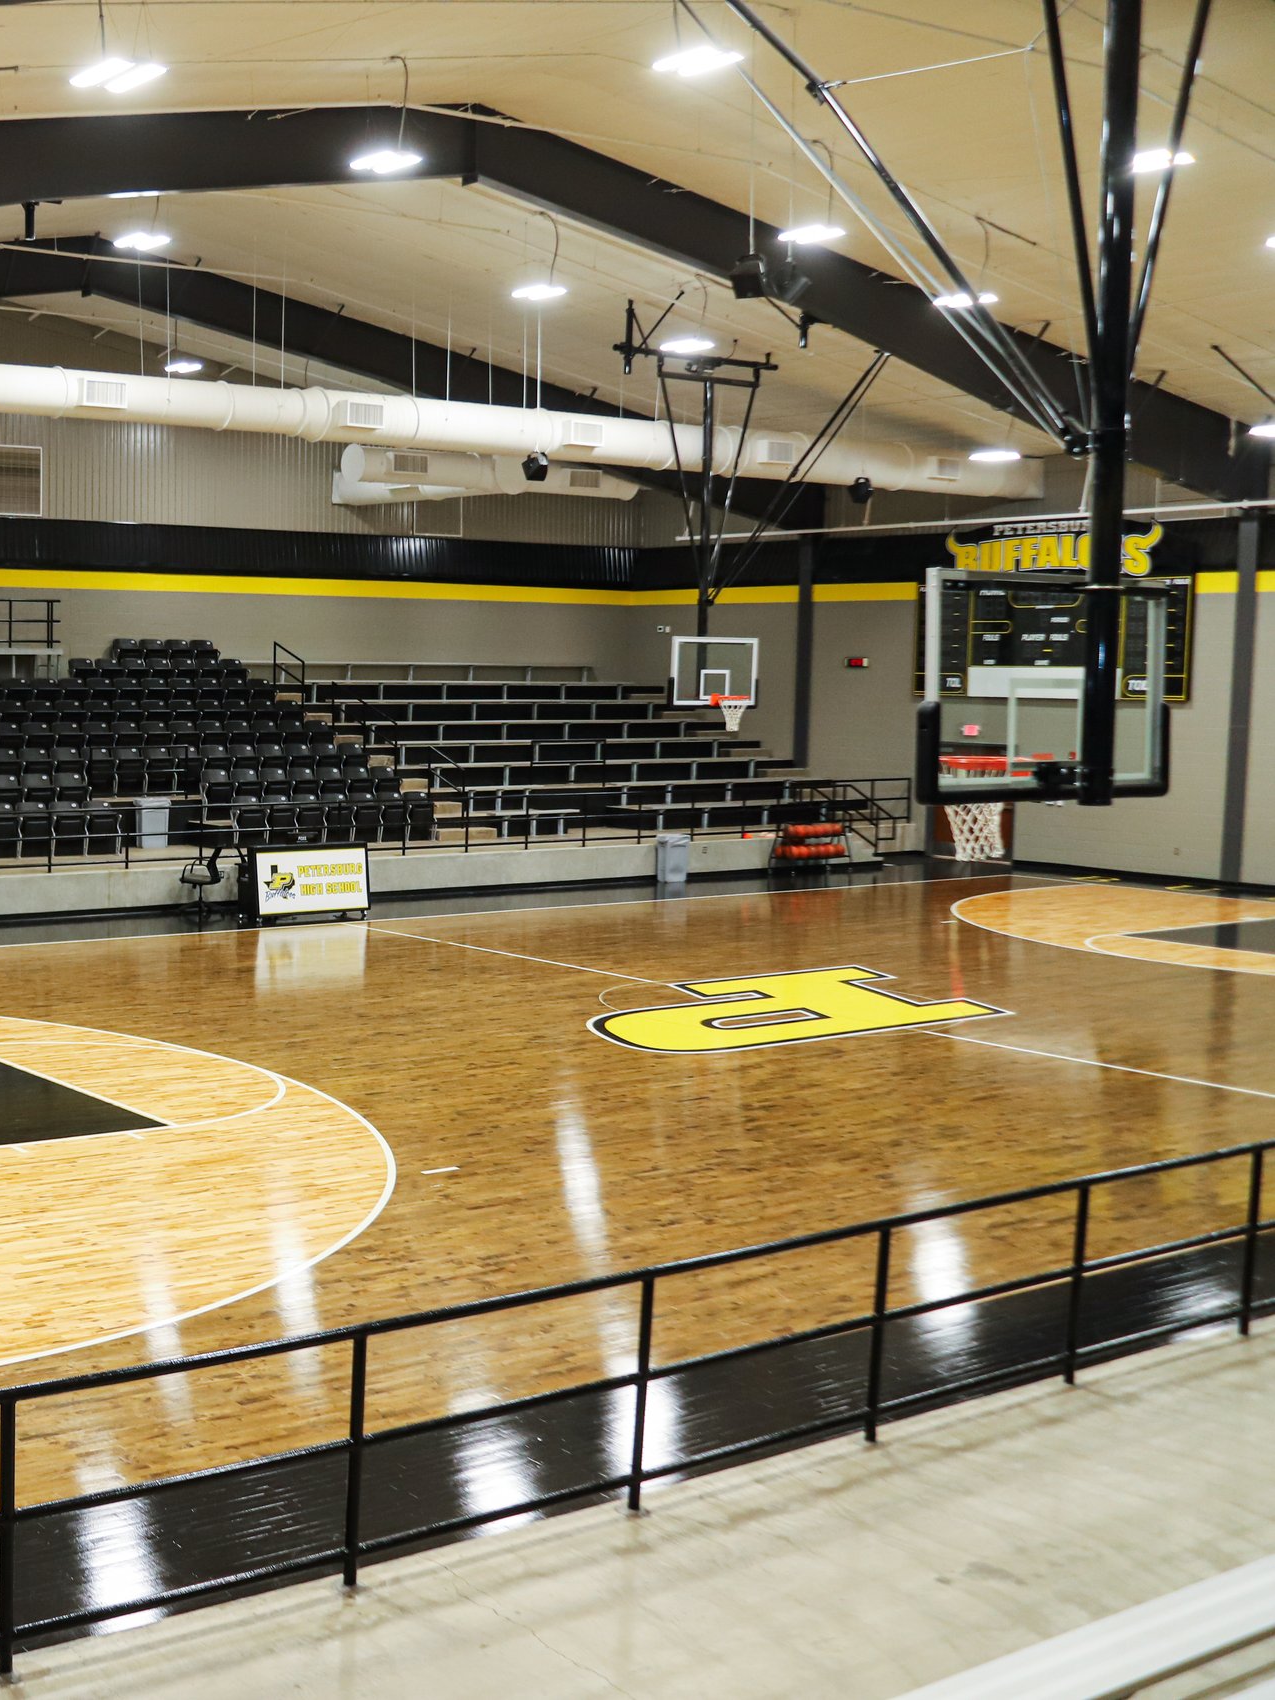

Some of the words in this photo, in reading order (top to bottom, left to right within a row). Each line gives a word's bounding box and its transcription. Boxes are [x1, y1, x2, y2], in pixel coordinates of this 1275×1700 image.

[993, 519, 1091, 536] PETERSBUR
[947, 527, 1157, 577] BUFFALOS
[297, 863, 363, 877] PETERSBURG
[300, 883, 323, 896] HIGH
[326, 881, 362, 894] SCHOOL
[585, 964, 1016, 1055] P
